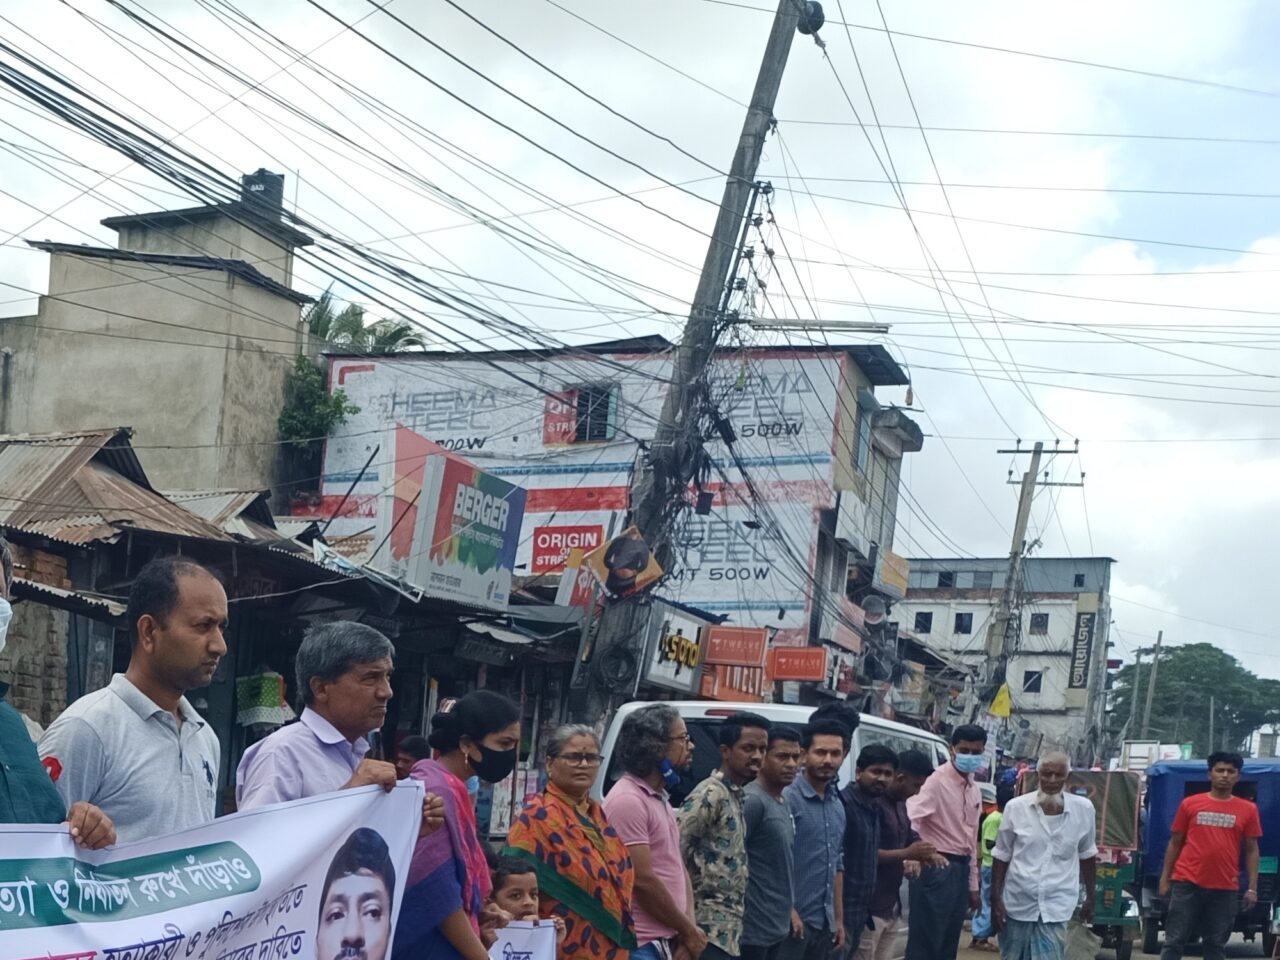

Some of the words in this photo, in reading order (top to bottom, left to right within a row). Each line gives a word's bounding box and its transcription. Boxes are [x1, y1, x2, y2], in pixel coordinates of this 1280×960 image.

[740, 422, 803, 437] 500W
[453, 482, 510, 532] BERGER
[537, 532, 597, 548] ORIGIN
[709, 567, 770, 581] 500W
[723, 639, 760, 650] TWELVE
[47, 879, 69, 909] ও
[133, 866, 190, 903] রুখে
[184, 854, 252, 891] দাঁড়াও
[185, 931, 202, 958] ও
